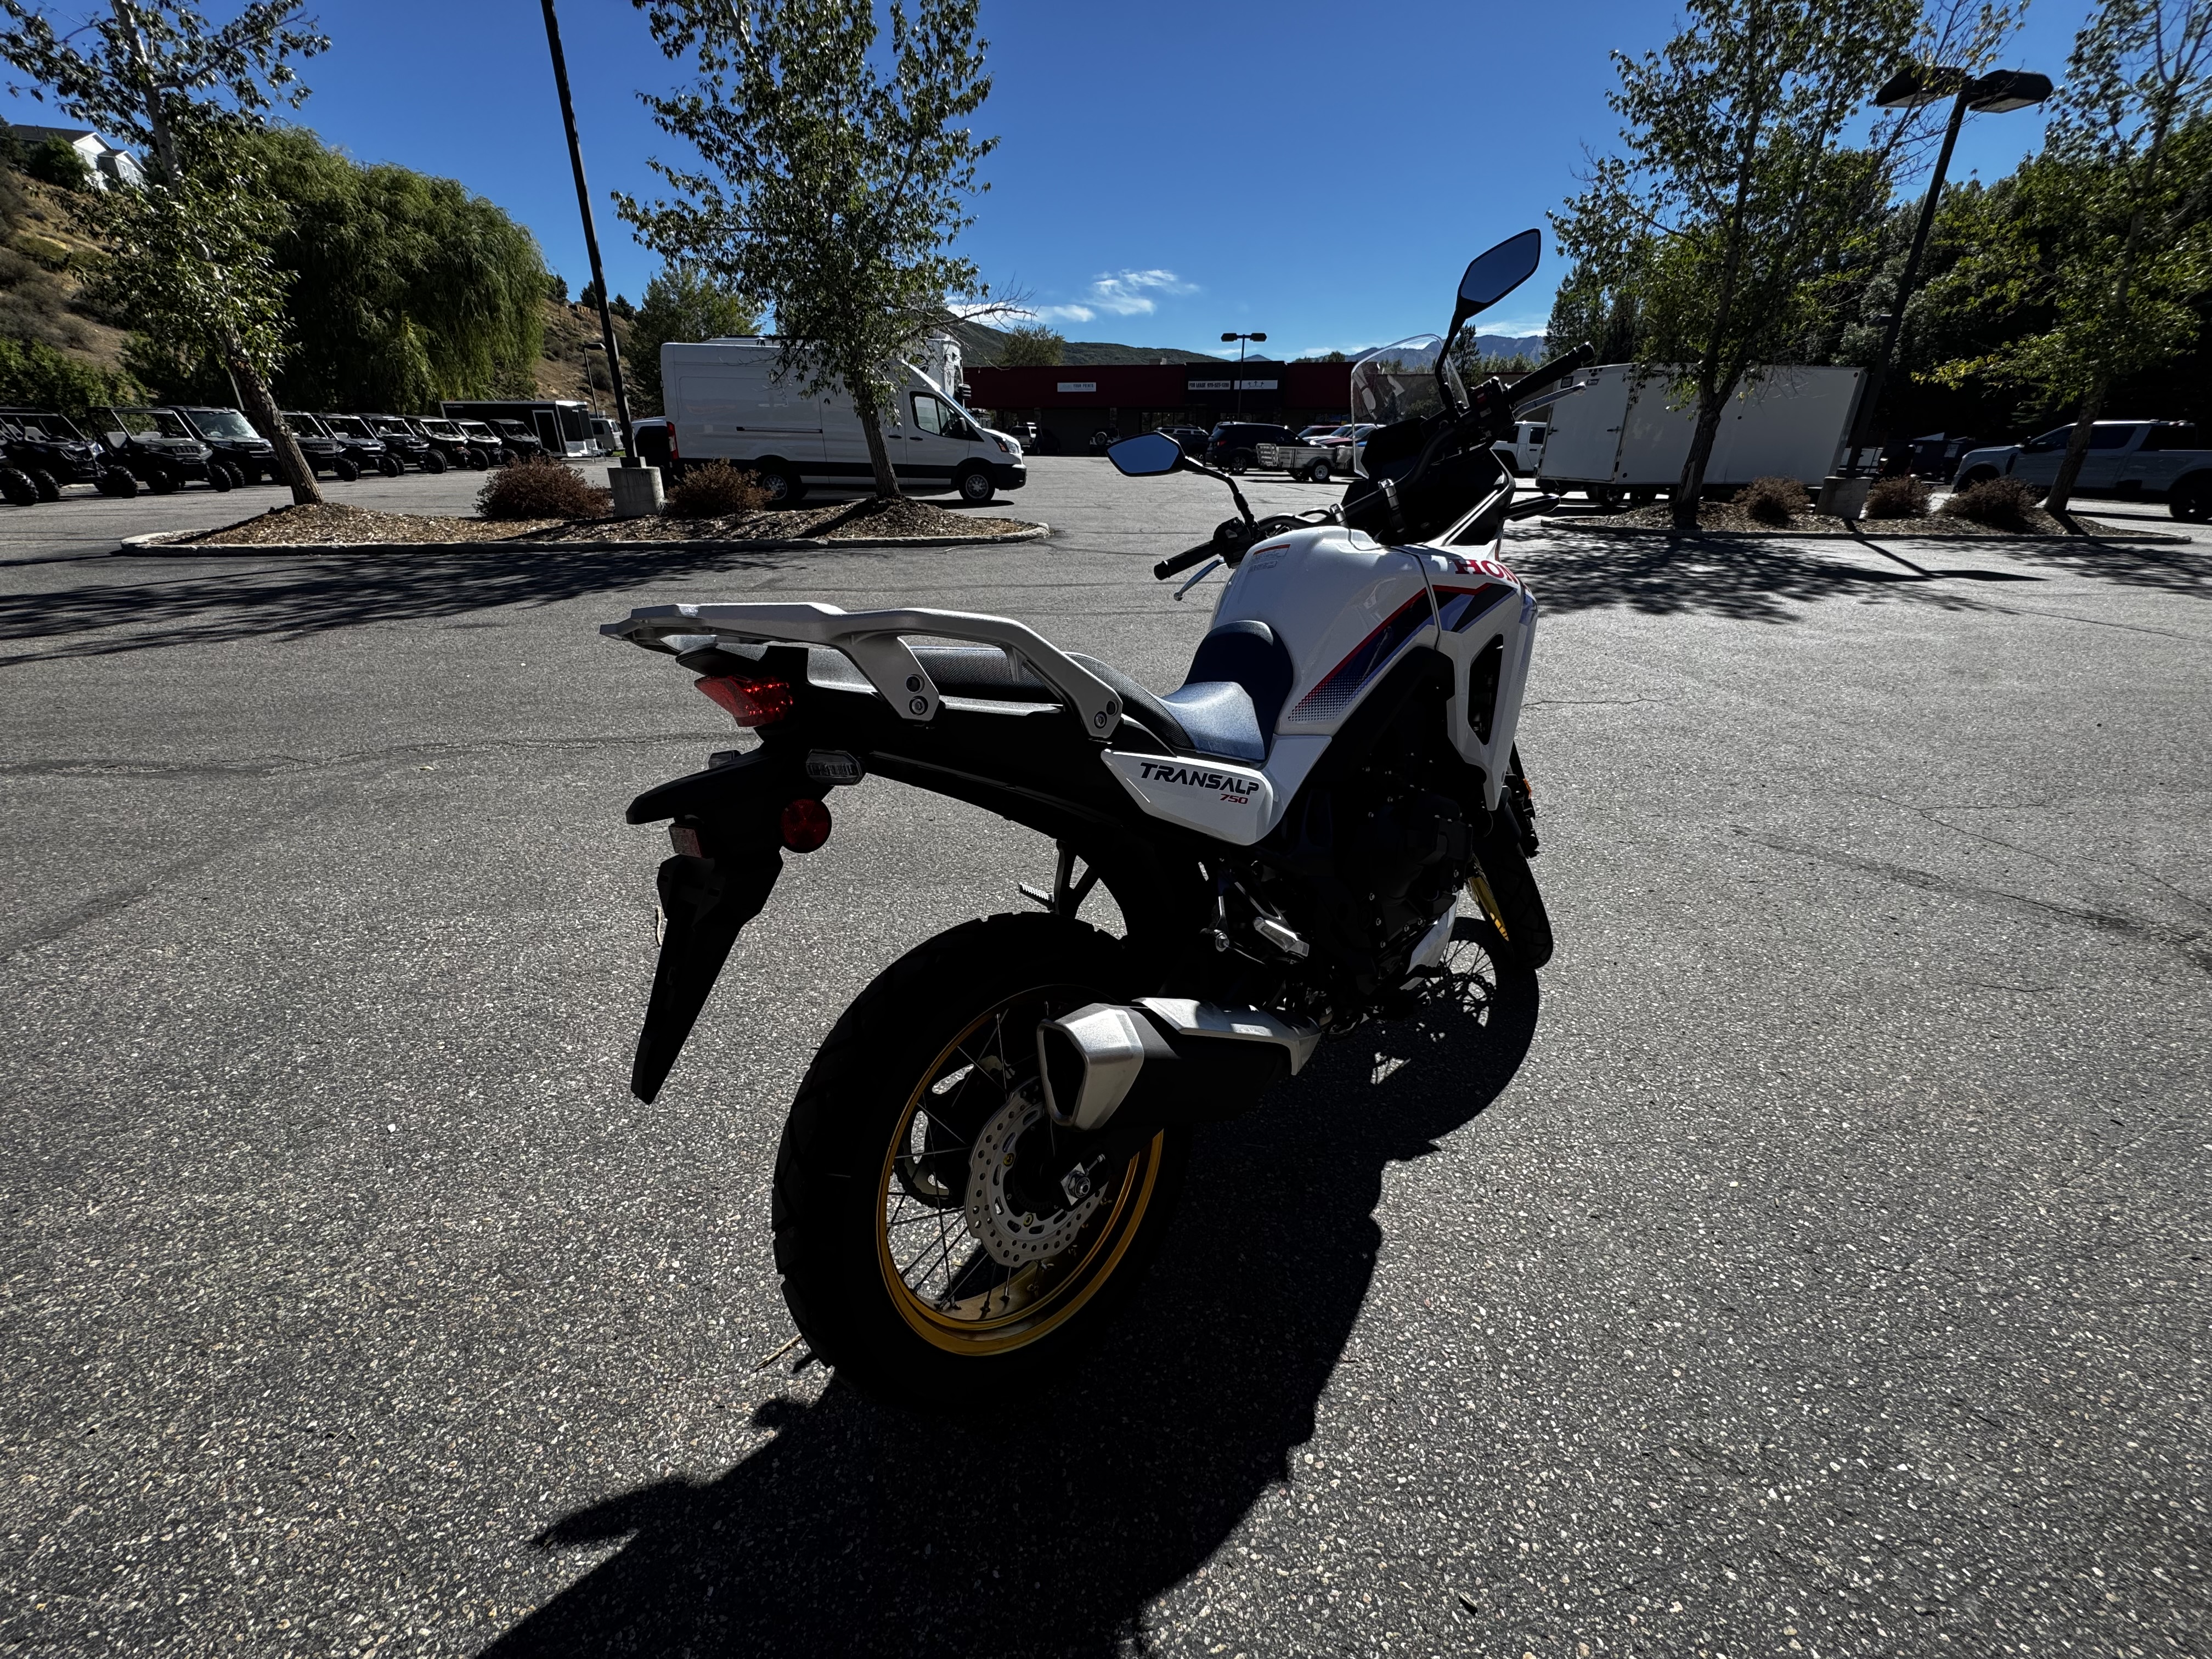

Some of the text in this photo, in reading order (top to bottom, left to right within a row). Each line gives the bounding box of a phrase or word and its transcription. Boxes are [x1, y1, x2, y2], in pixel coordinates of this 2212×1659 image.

[1448, 558, 1520, 585] HON
[1140, 762, 1260, 795] TRANSALP
[1220, 793, 1249, 805] 750
